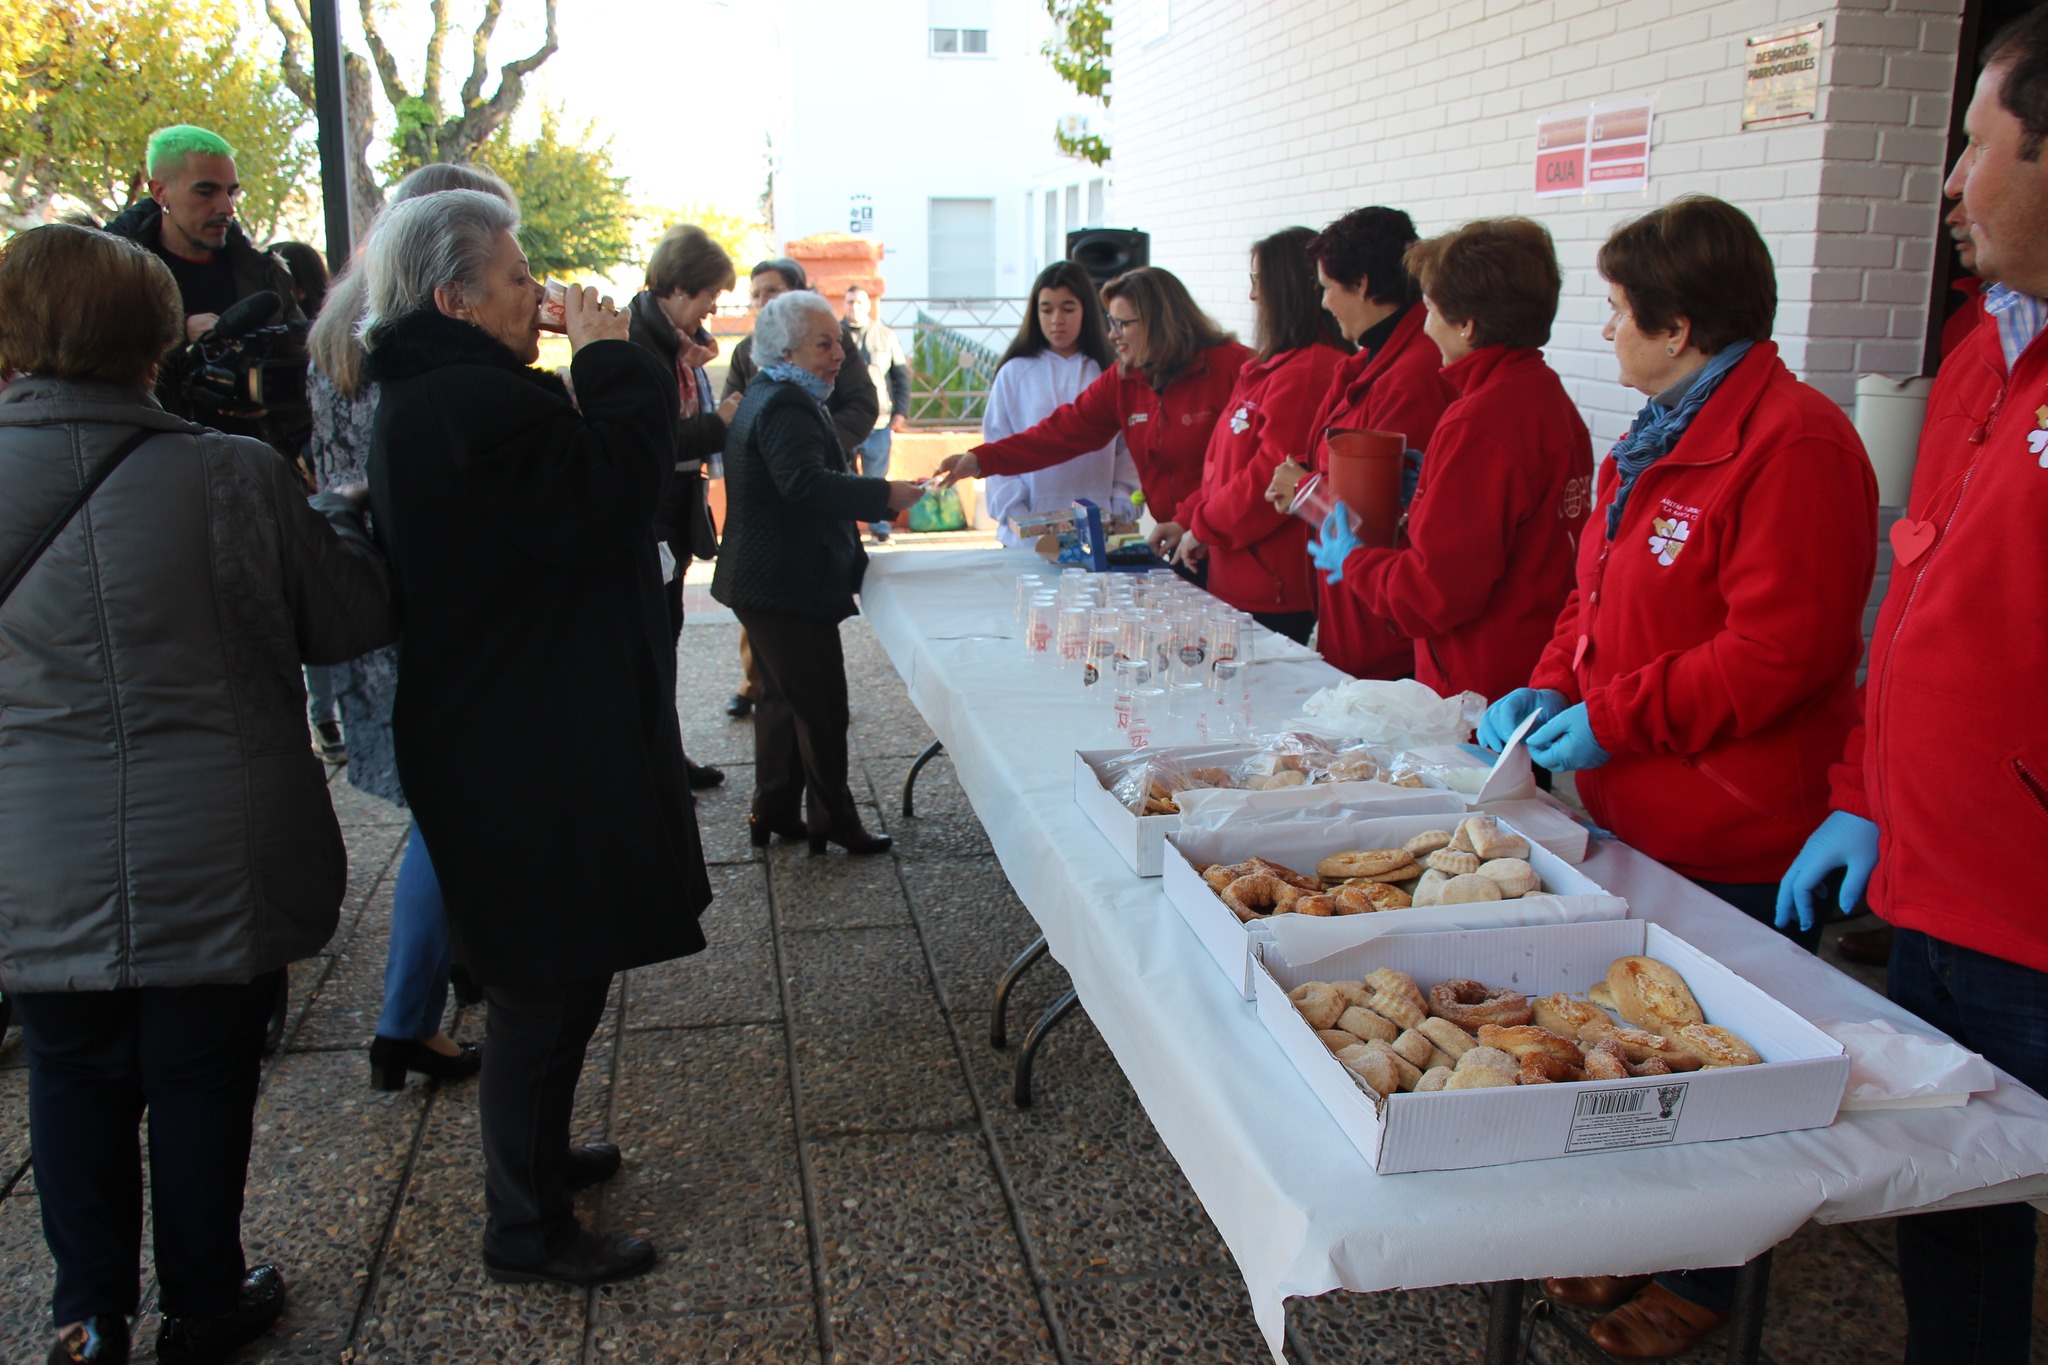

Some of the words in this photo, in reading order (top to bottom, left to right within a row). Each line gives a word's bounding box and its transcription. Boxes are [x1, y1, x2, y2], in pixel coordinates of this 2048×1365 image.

[1756, 43, 1809, 64] DESPACHOS
[1748, 58, 1815, 80] PARROQUIALES
[1546, 160, 1575, 183] CAJA
